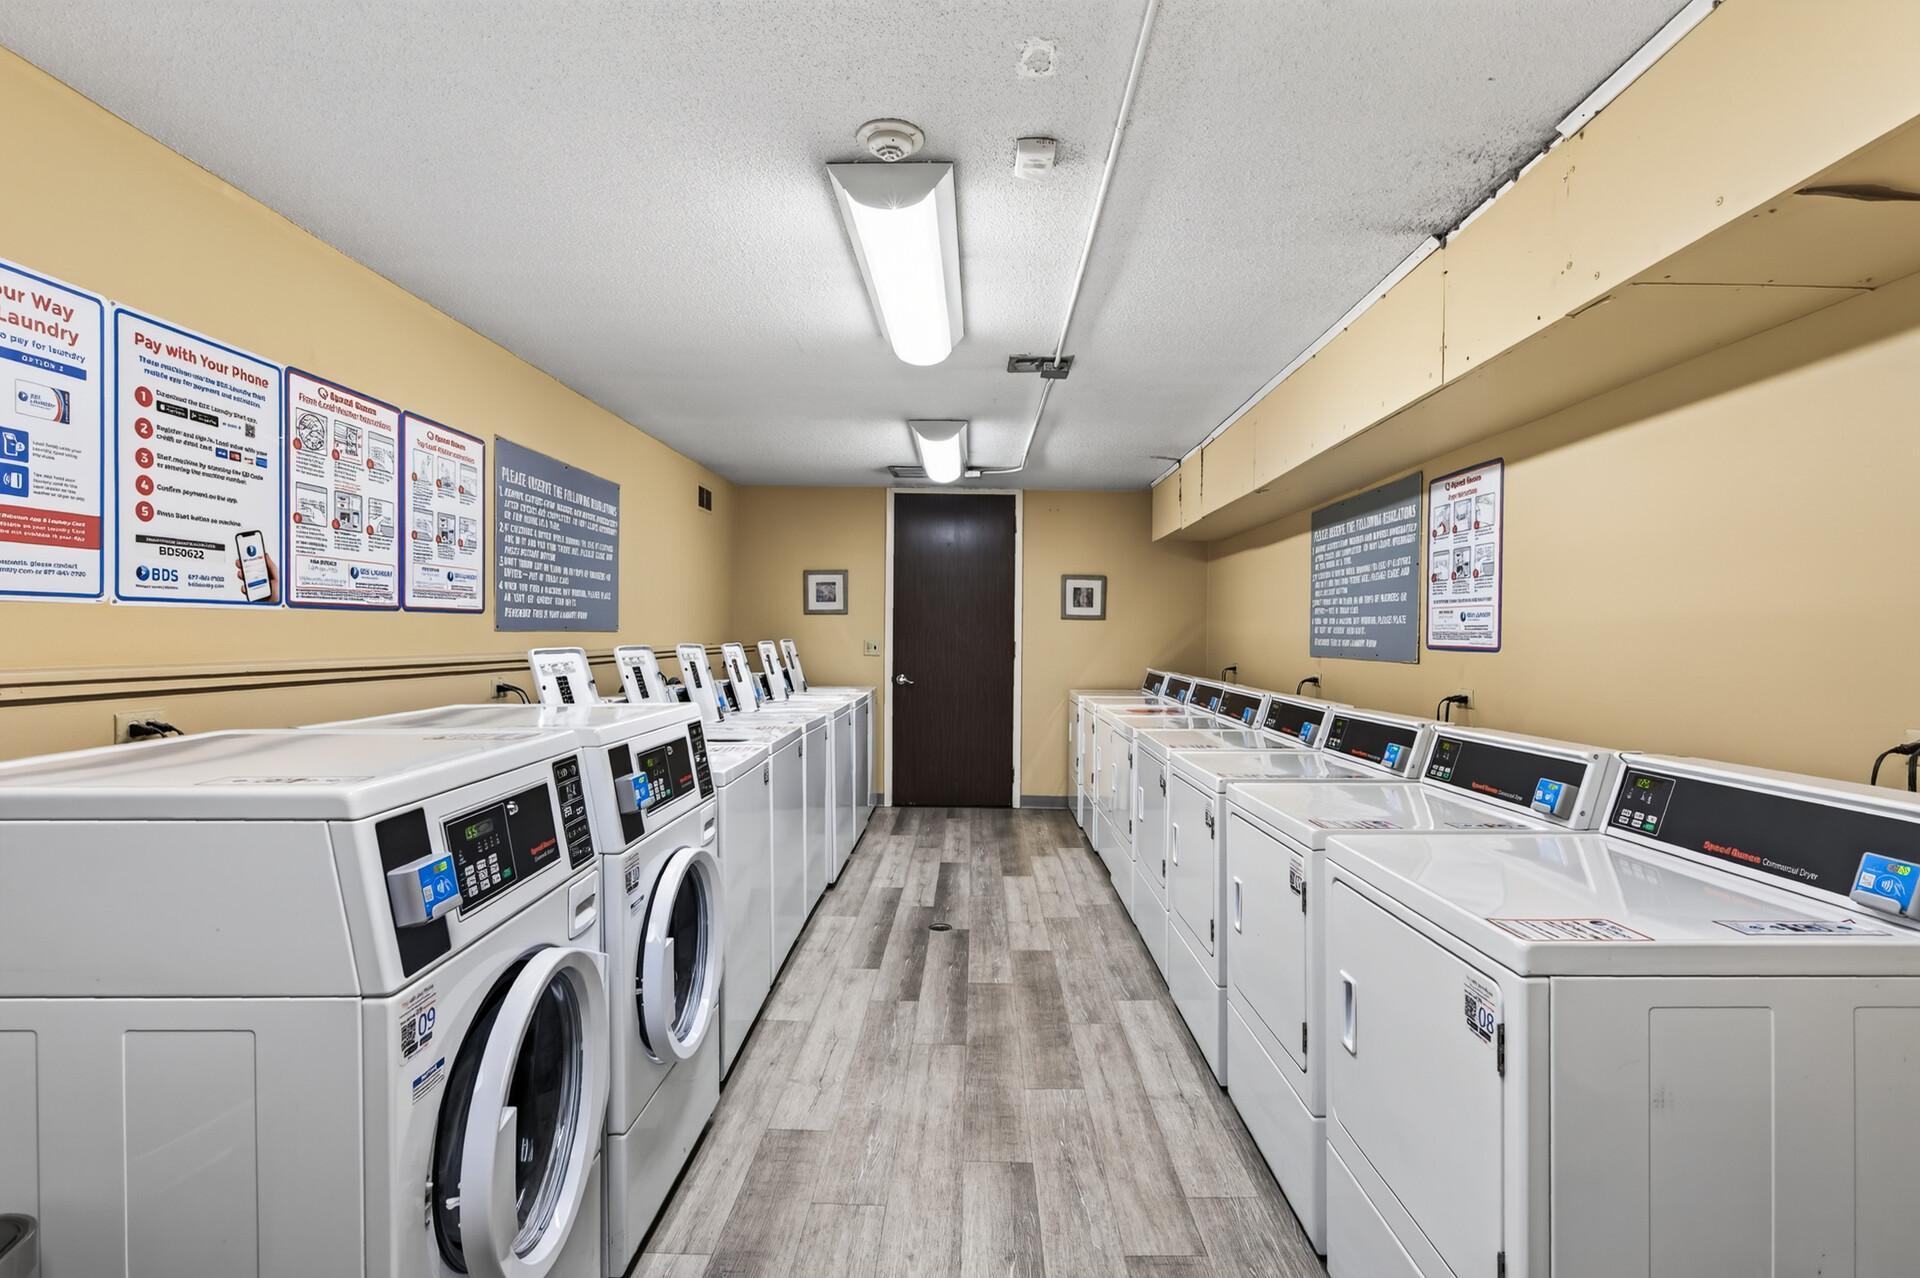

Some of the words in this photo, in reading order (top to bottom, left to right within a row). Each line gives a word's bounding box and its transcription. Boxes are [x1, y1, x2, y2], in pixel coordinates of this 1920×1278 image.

[0, 286, 25, 303] ur
[31, 292, 74, 322] Way
[10, 336, 28, 347] pay
[32, 341, 45, 350] for
[21, 355, 55, 370] OPTION
[134, 331, 161, 355] Pay
[165, 341, 196, 365] with
[200, 354, 228, 375] Your
[232, 365, 268, 389] Phone
[140, 390, 145, 402] 1
[140, 422, 147, 434] 2
[140, 452, 147, 463] 3
[501, 466, 526, 487] PLEASE
[141, 479, 148, 490] 4
[141, 506, 148, 516] 5
[151, 567, 178, 582] BDS
[1703, 840, 1731, 855] Speed
[1762, 857, 1800, 875] Commercial
[1799, 868, 1818, 880] Dryer
[418, 1006, 436, 1036] 09
[1479, 1007, 1494, 1034] 08
